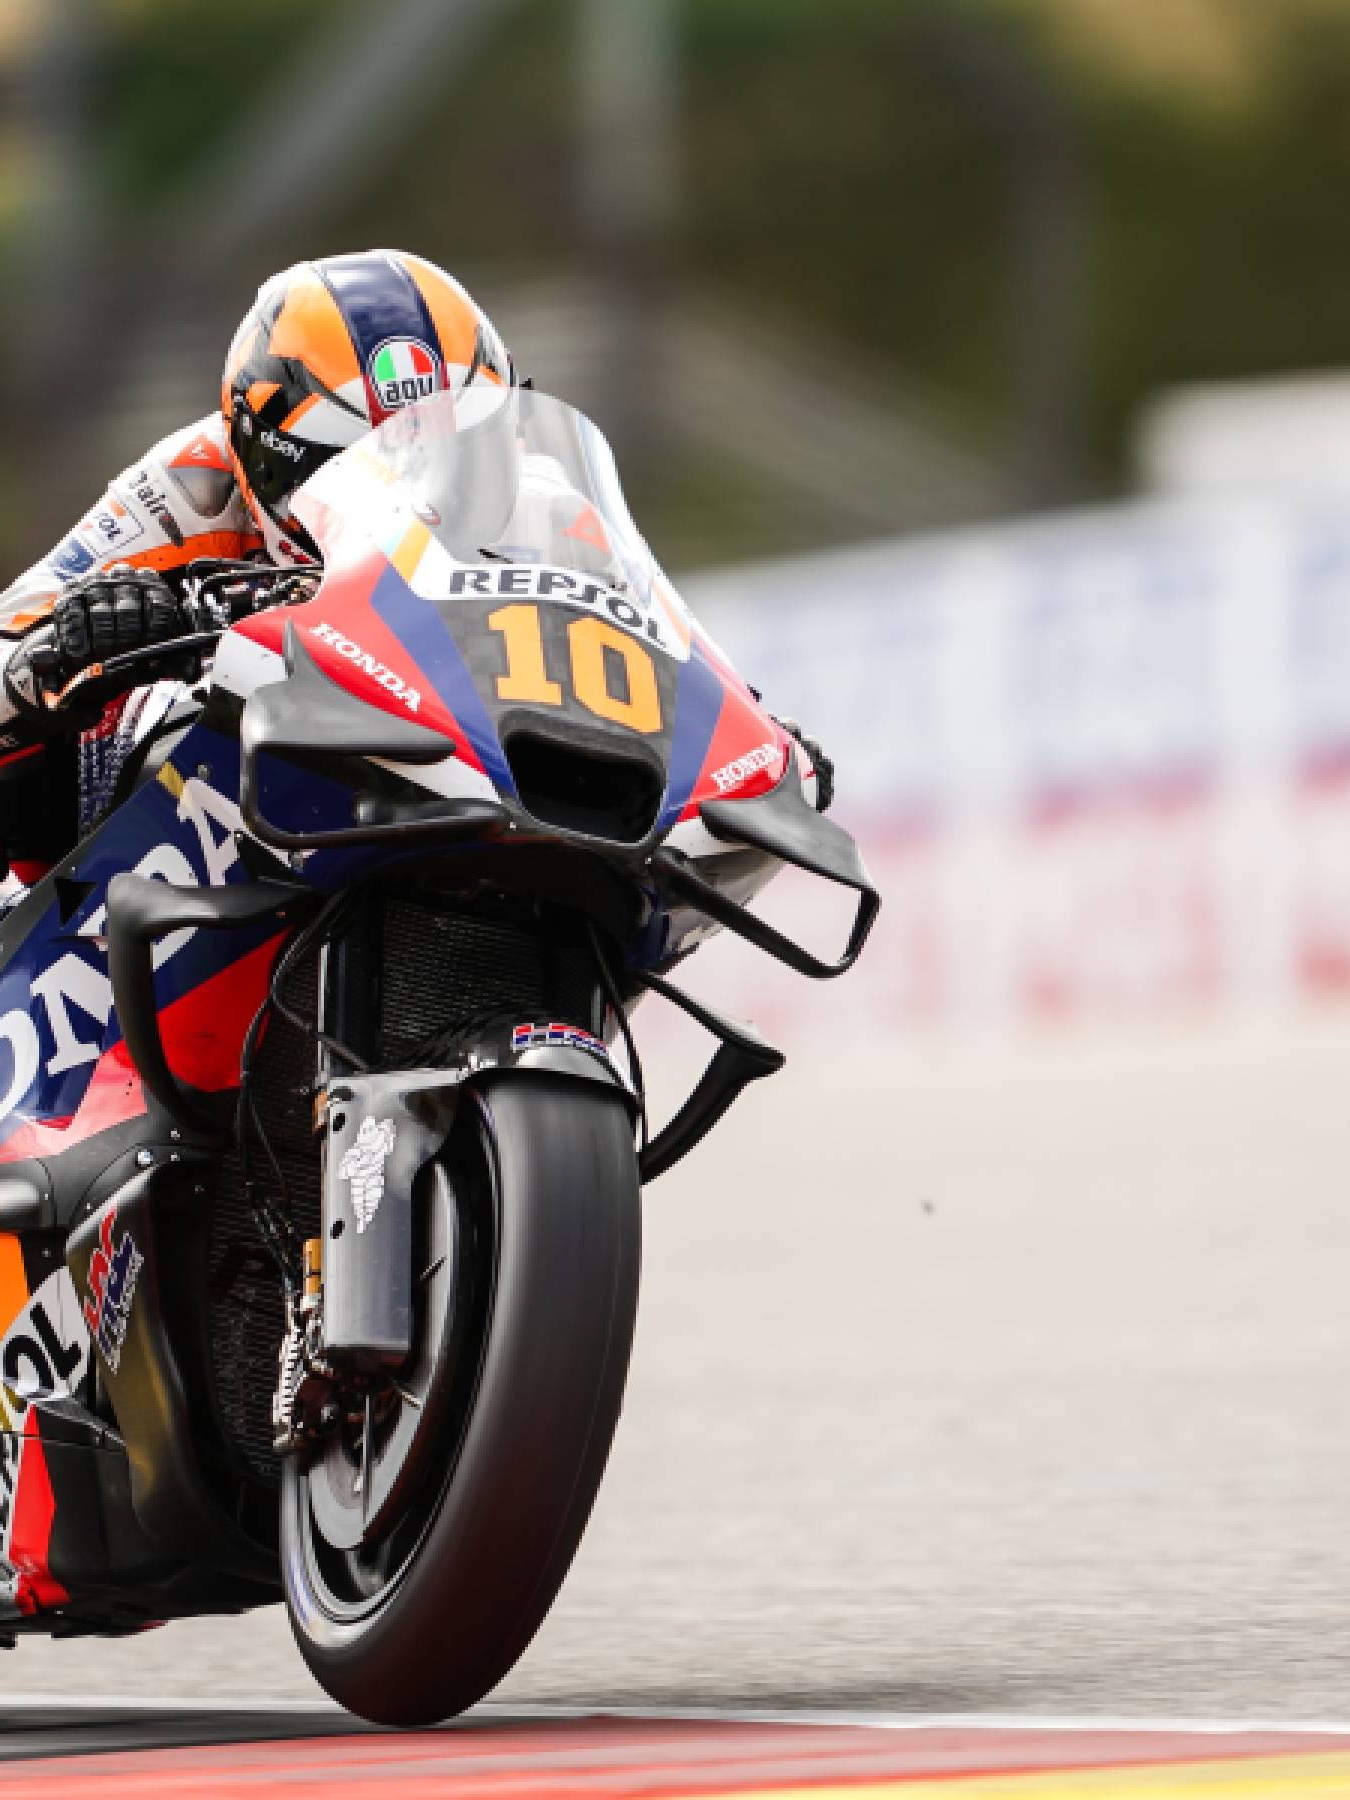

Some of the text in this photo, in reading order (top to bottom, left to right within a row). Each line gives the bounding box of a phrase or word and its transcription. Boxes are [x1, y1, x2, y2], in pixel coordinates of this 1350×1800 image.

[447, 566, 667, 652] REPSOL
[308, 621, 422, 713] HONDA
[487, 602, 664, 732] 10
[709, 743, 784, 792] HONDA
